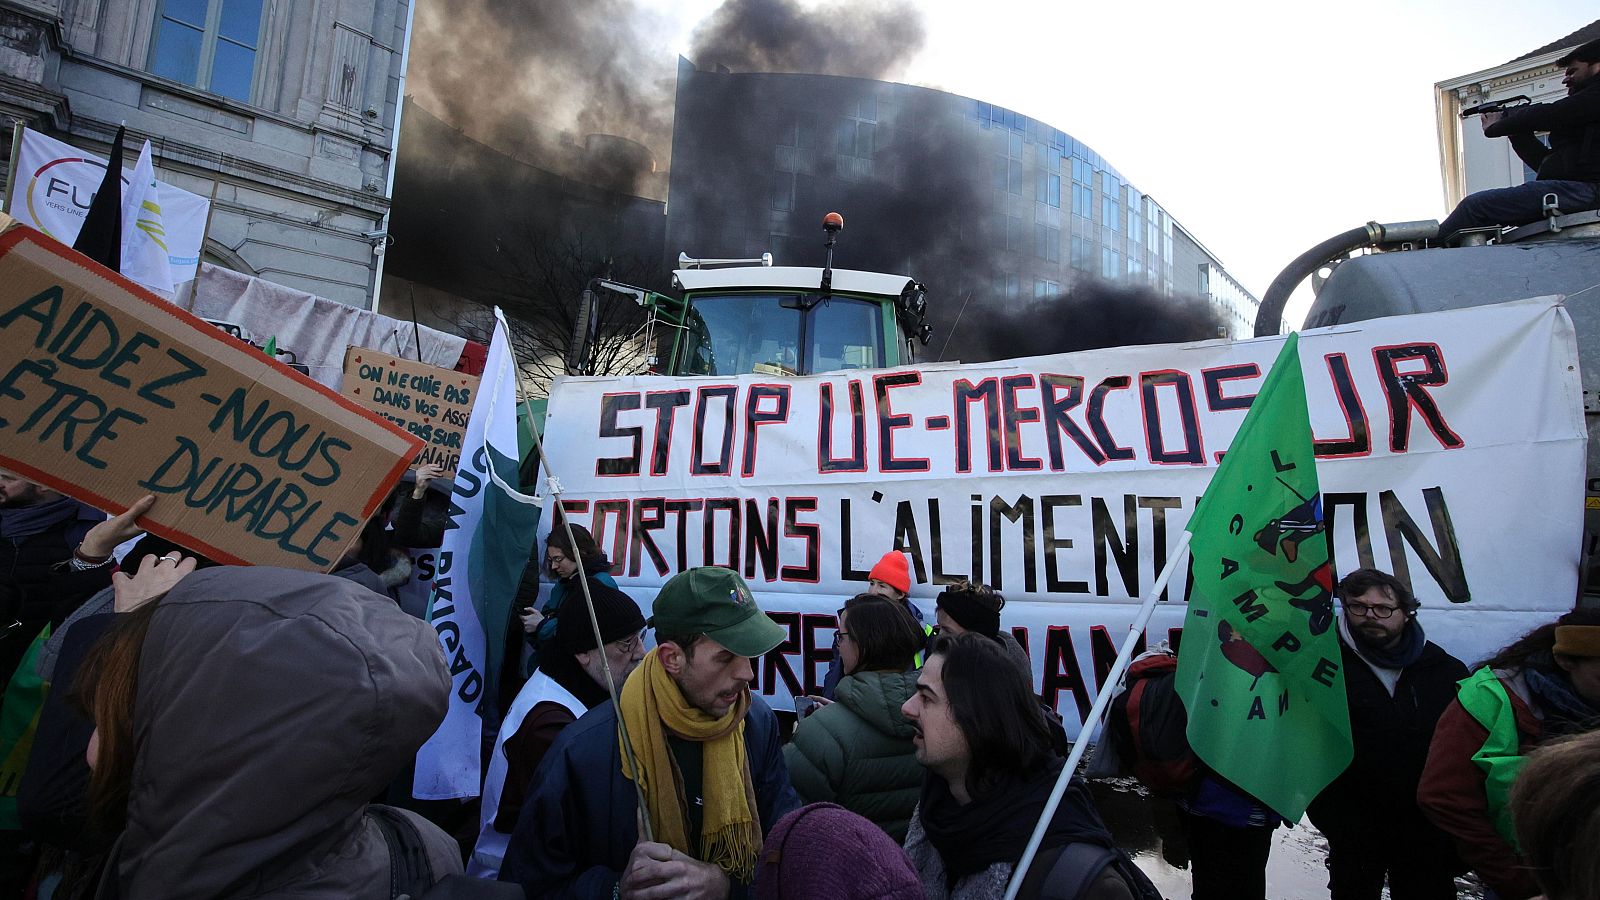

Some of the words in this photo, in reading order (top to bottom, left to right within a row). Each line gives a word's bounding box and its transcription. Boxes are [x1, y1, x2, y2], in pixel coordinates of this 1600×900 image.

[358, 364, 383, 382] ON
[387, 371, 410, 389] NE
[443, 384, 470, 405] PAS
[373, 387, 411, 410] DANS
[432, 428, 461, 449] SUR
[595, 384, 791, 478] STOP
[138, 436, 359, 566] DURABLE
